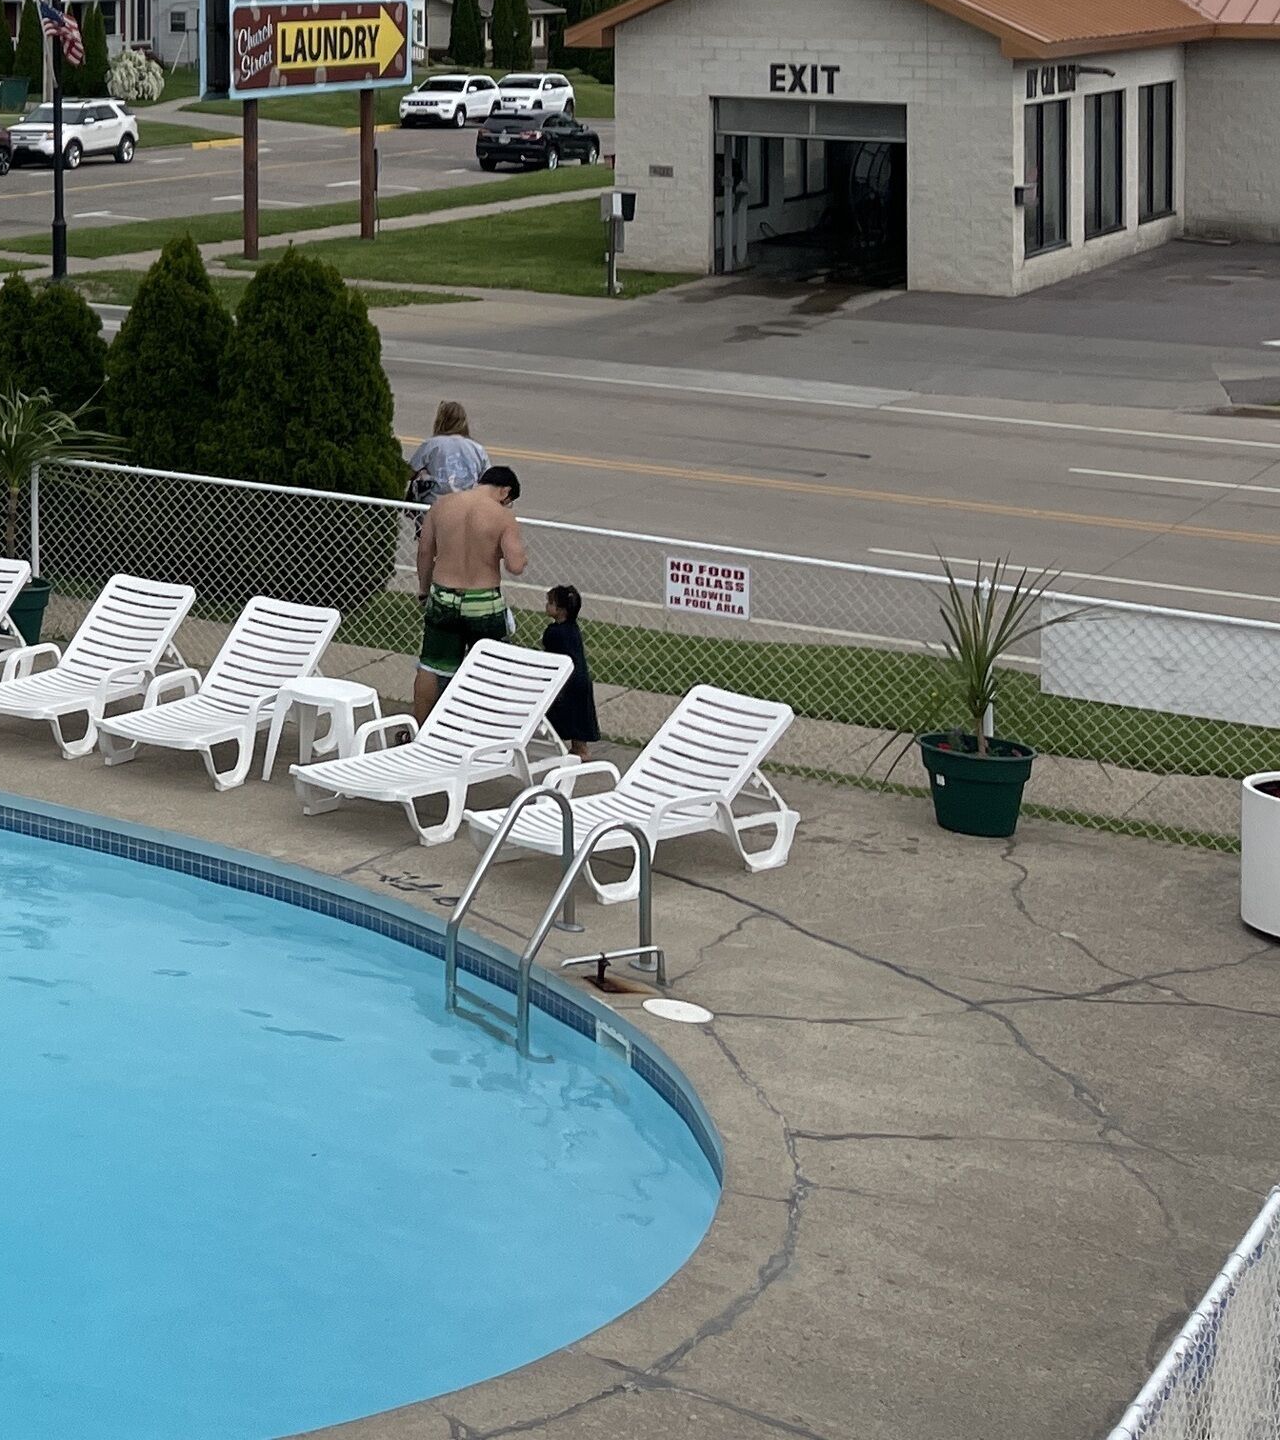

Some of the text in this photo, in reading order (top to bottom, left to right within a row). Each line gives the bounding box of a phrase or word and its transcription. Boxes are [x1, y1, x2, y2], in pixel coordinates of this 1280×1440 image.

[237, 14, 274, 56] Church
[281, 24, 380, 63] LAUNDRY
[241, 44, 272, 81] Street
[770, 63, 840, 94] EXIT
[670, 561, 744, 580] NO FOOD
[670, 573, 744, 593] OR GLASS
[670, 595, 744, 615] IN POOL AREA
[683, 588, 731, 602] ALLOWED
